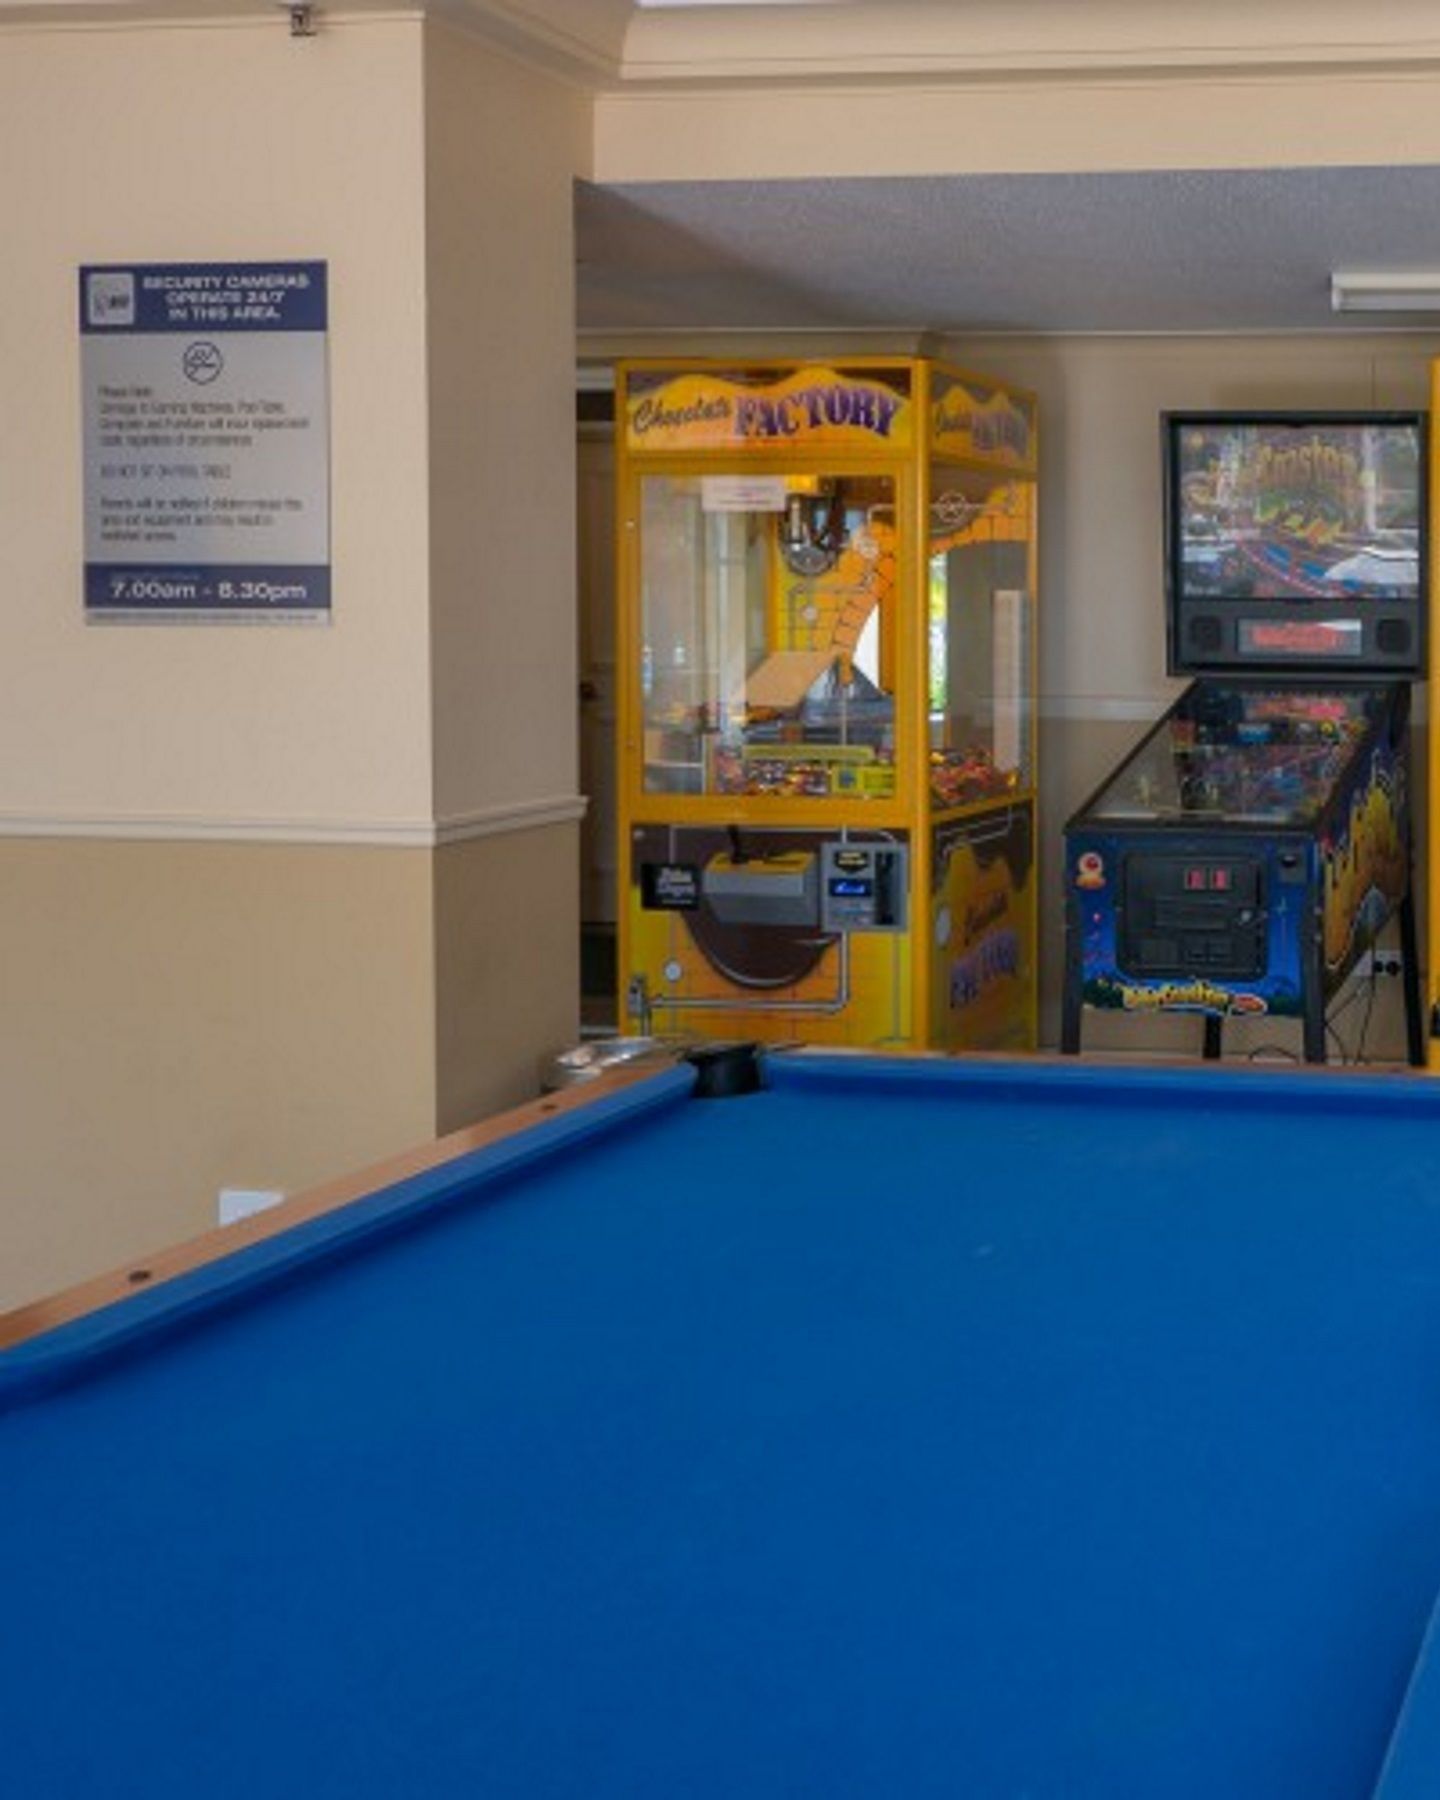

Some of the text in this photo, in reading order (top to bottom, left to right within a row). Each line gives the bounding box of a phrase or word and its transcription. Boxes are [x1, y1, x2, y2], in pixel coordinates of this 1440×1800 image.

[143, 274, 310, 289] SECURITY CAMERAS
[165, 291, 286, 304] OPERATE 24/7
[168, 307, 187, 321] IN
[192, 306, 228, 321] THIS
[734, 385, 901, 437] FACTORY
[110, 582, 197, 599] 7.00am
[218, 582, 308, 602] 8.30pm
